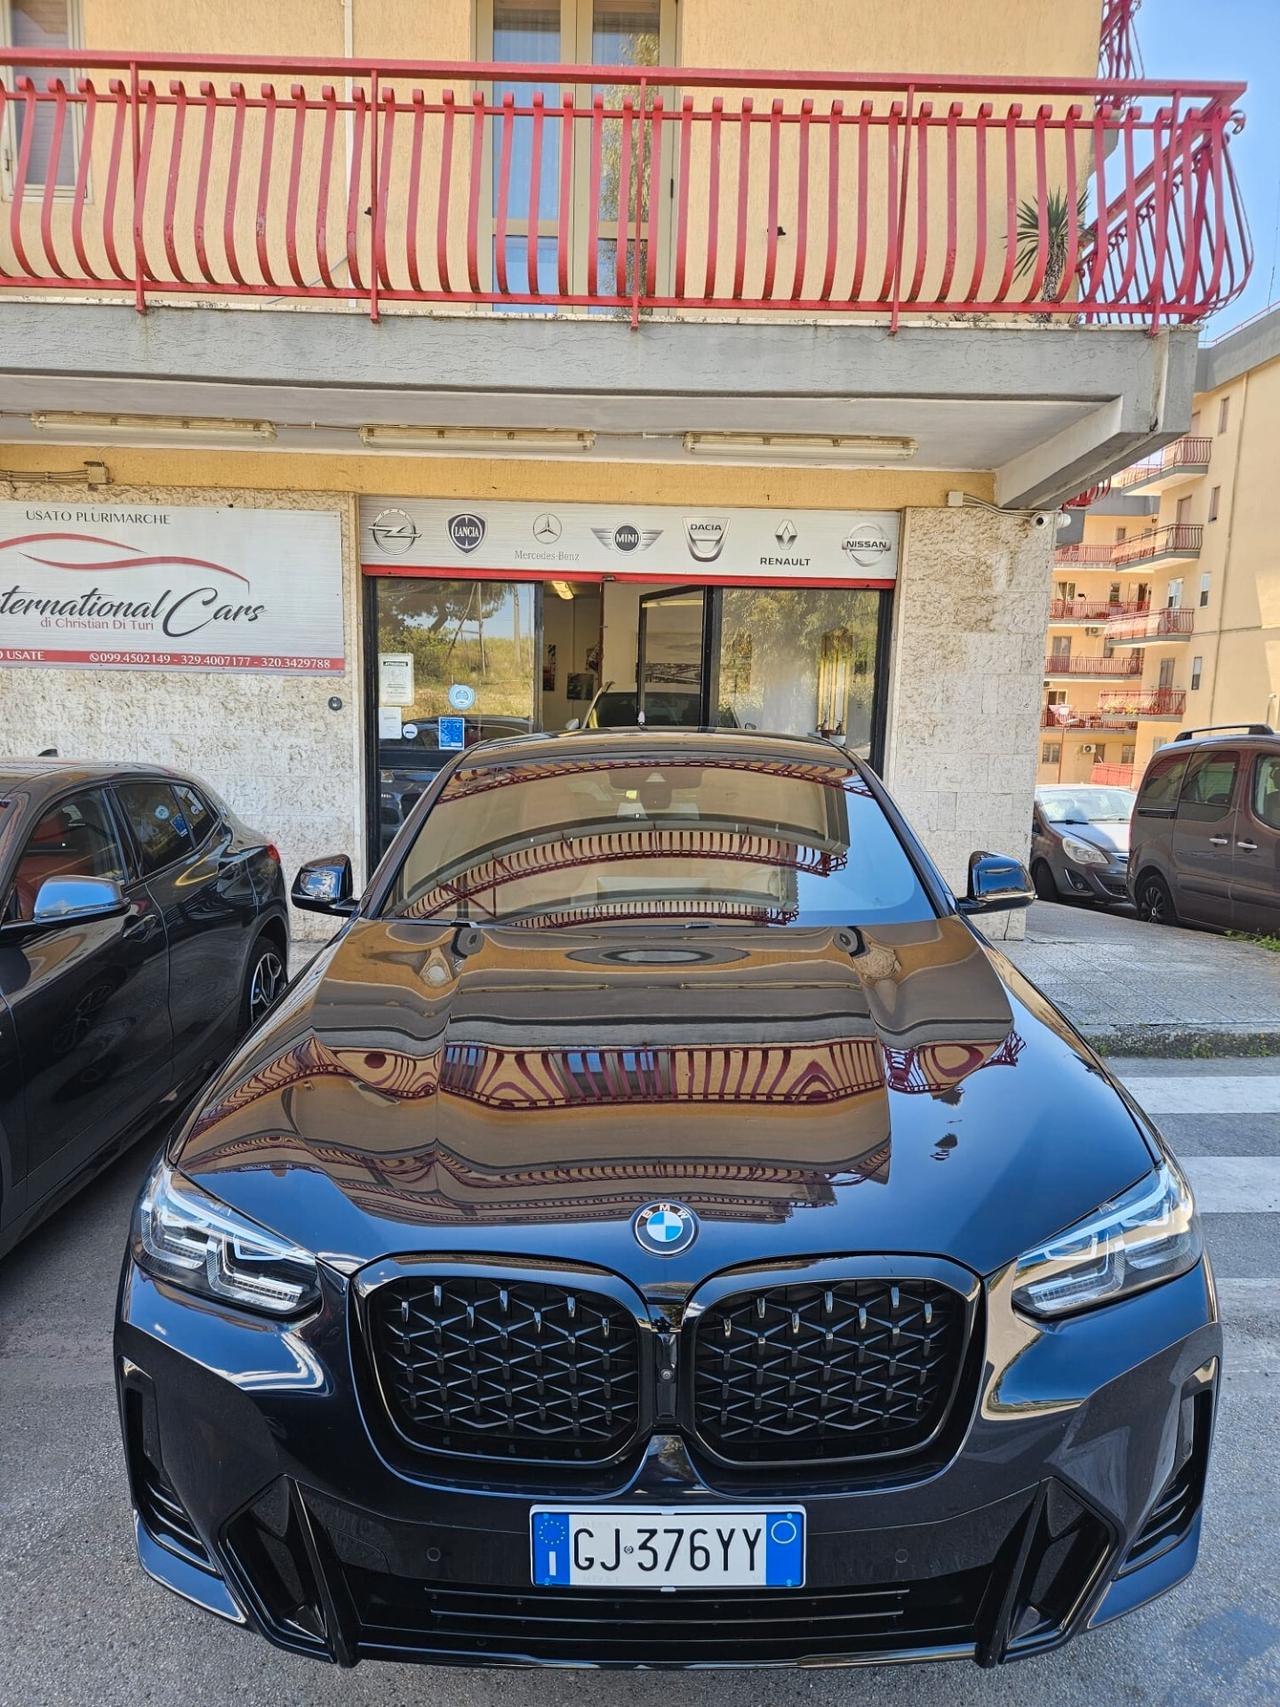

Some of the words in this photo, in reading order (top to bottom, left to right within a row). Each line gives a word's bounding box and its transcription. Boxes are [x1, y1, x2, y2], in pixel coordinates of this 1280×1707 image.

[26, 510, 72, 521] USATO
[76, 511, 171, 525] PLURIMARCHE
[454, 526, 480, 538] LANCIA
[690, 523, 722, 532] DACIA
[615, 533, 638, 544] MINI
[846, 541, 887, 549] NISSAN
[514, 550, 580, 561] Mercedes-Benz
[760, 557, 811, 567] RENAULT
[0, 585, 172, 618] ternational
[162, 587, 267, 638] Cars
[40, 617, 51, 628] di
[55, 618, 109, 629] Christian
[113, 619, 126, 630] Di
[130, 620, 154, 631] Turi
[7, 651, 46, 661] USATE
[100, 653, 170, 664] 099.4502149
[181, 655, 250, 666] 329.4007177
[261, 658, 330, 669] 320.3429788
[641, 1203, 689, 1219] BMW
